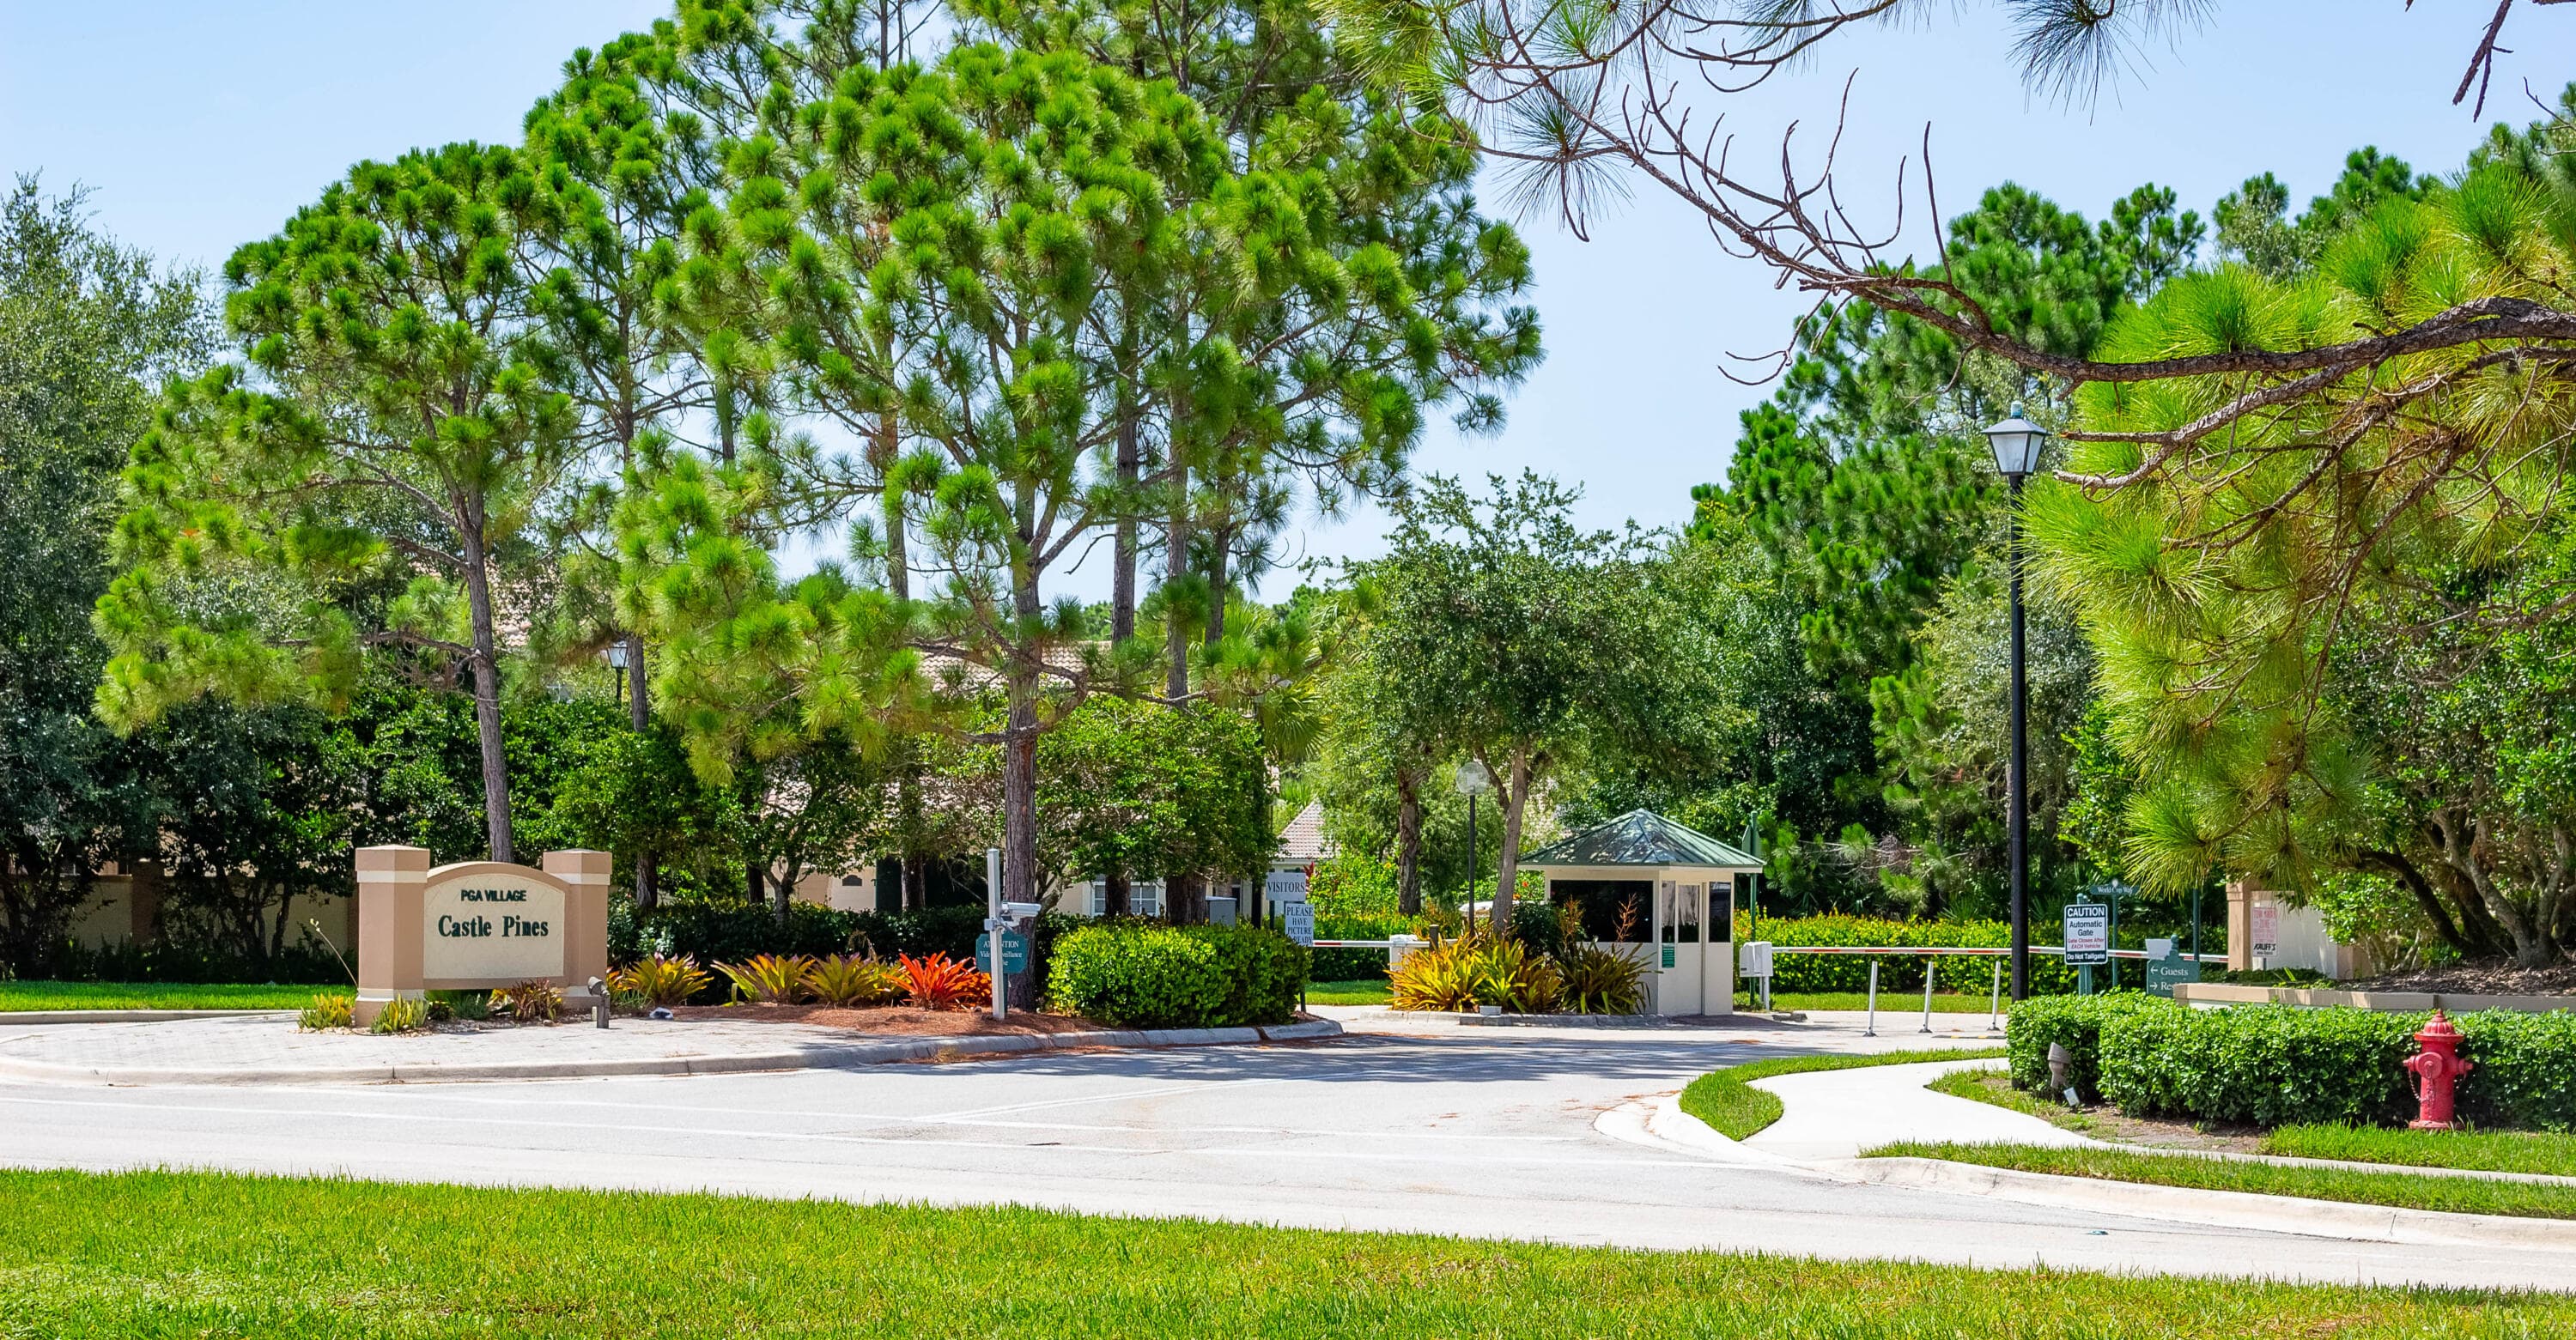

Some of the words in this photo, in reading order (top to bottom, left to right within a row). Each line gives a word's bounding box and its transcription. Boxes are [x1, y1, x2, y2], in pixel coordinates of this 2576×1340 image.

[1267, 882, 1305, 893] VISITORS
[460, 889, 484, 901] PGA
[485, 889, 526, 901] VILLAGE
[1286, 906, 1314, 916] PLEASE
[2067, 907, 2105, 917] CAUTION
[438, 915, 492, 937] Castle
[501, 915, 549, 937] Pines
[2160, 967, 2189, 976] Guests
